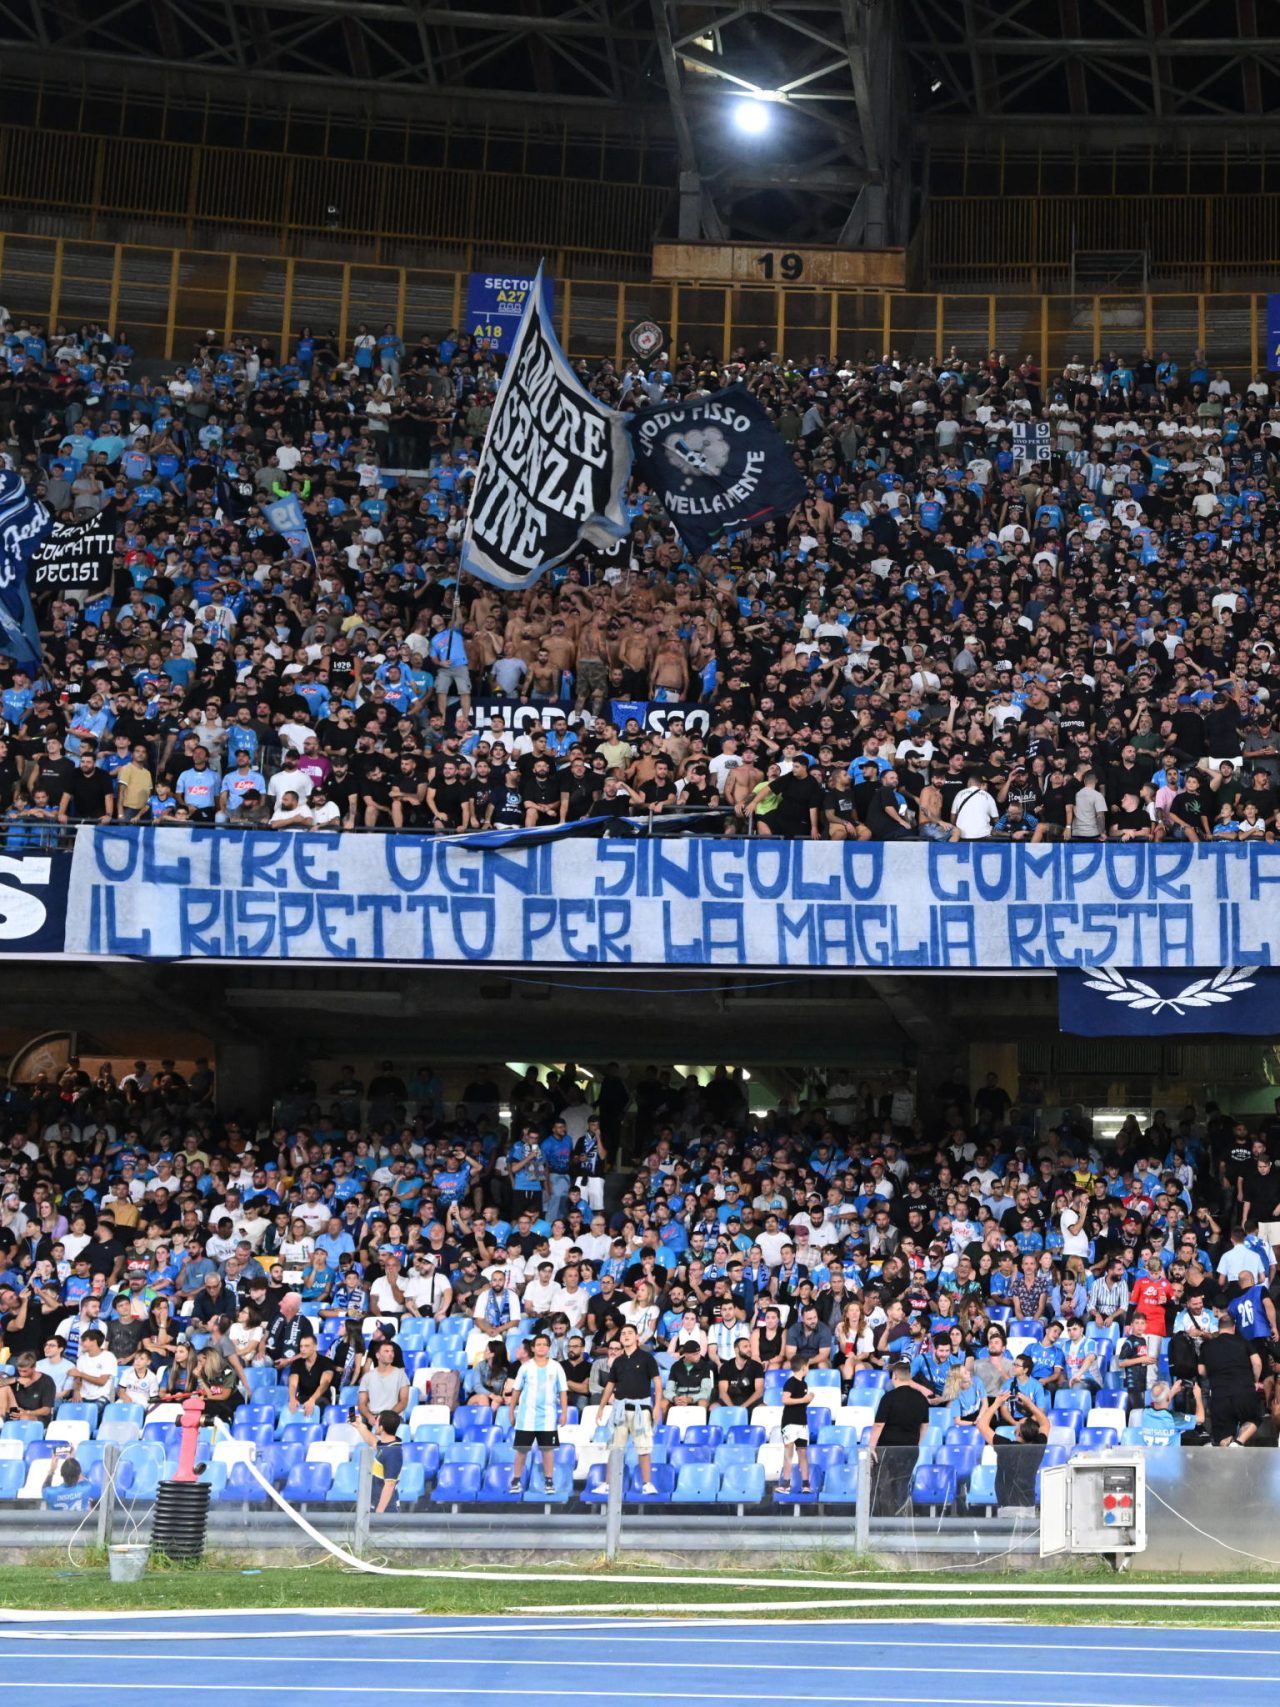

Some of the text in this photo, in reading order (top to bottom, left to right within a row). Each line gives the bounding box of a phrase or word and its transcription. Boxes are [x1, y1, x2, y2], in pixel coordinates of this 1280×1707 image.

[757, 252, 804, 281] 19
[496, 291, 526, 304] A27
[473, 324, 503, 338] A18
[492, 384, 597, 523] SENZA
[664, 450, 766, 515] NELLA MENTE
[35, 561, 100, 584] DECISI
[93, 824, 341, 890] OLTRE
[385, 833, 553, 897] OGNI
[594, 837, 885, 902] SINGOLO
[89, 883, 151, 956] IL
[179, 886, 497, 961] RISPETTO
[522, 896, 632, 963] PER
[662, 899, 747, 965] LA
[776, 902, 977, 967] MAGLIA
[1007, 903, 1195, 967] RESTA
[1219, 901, 1272, 967] IL
[1237, 1299, 1255, 1328] 26
